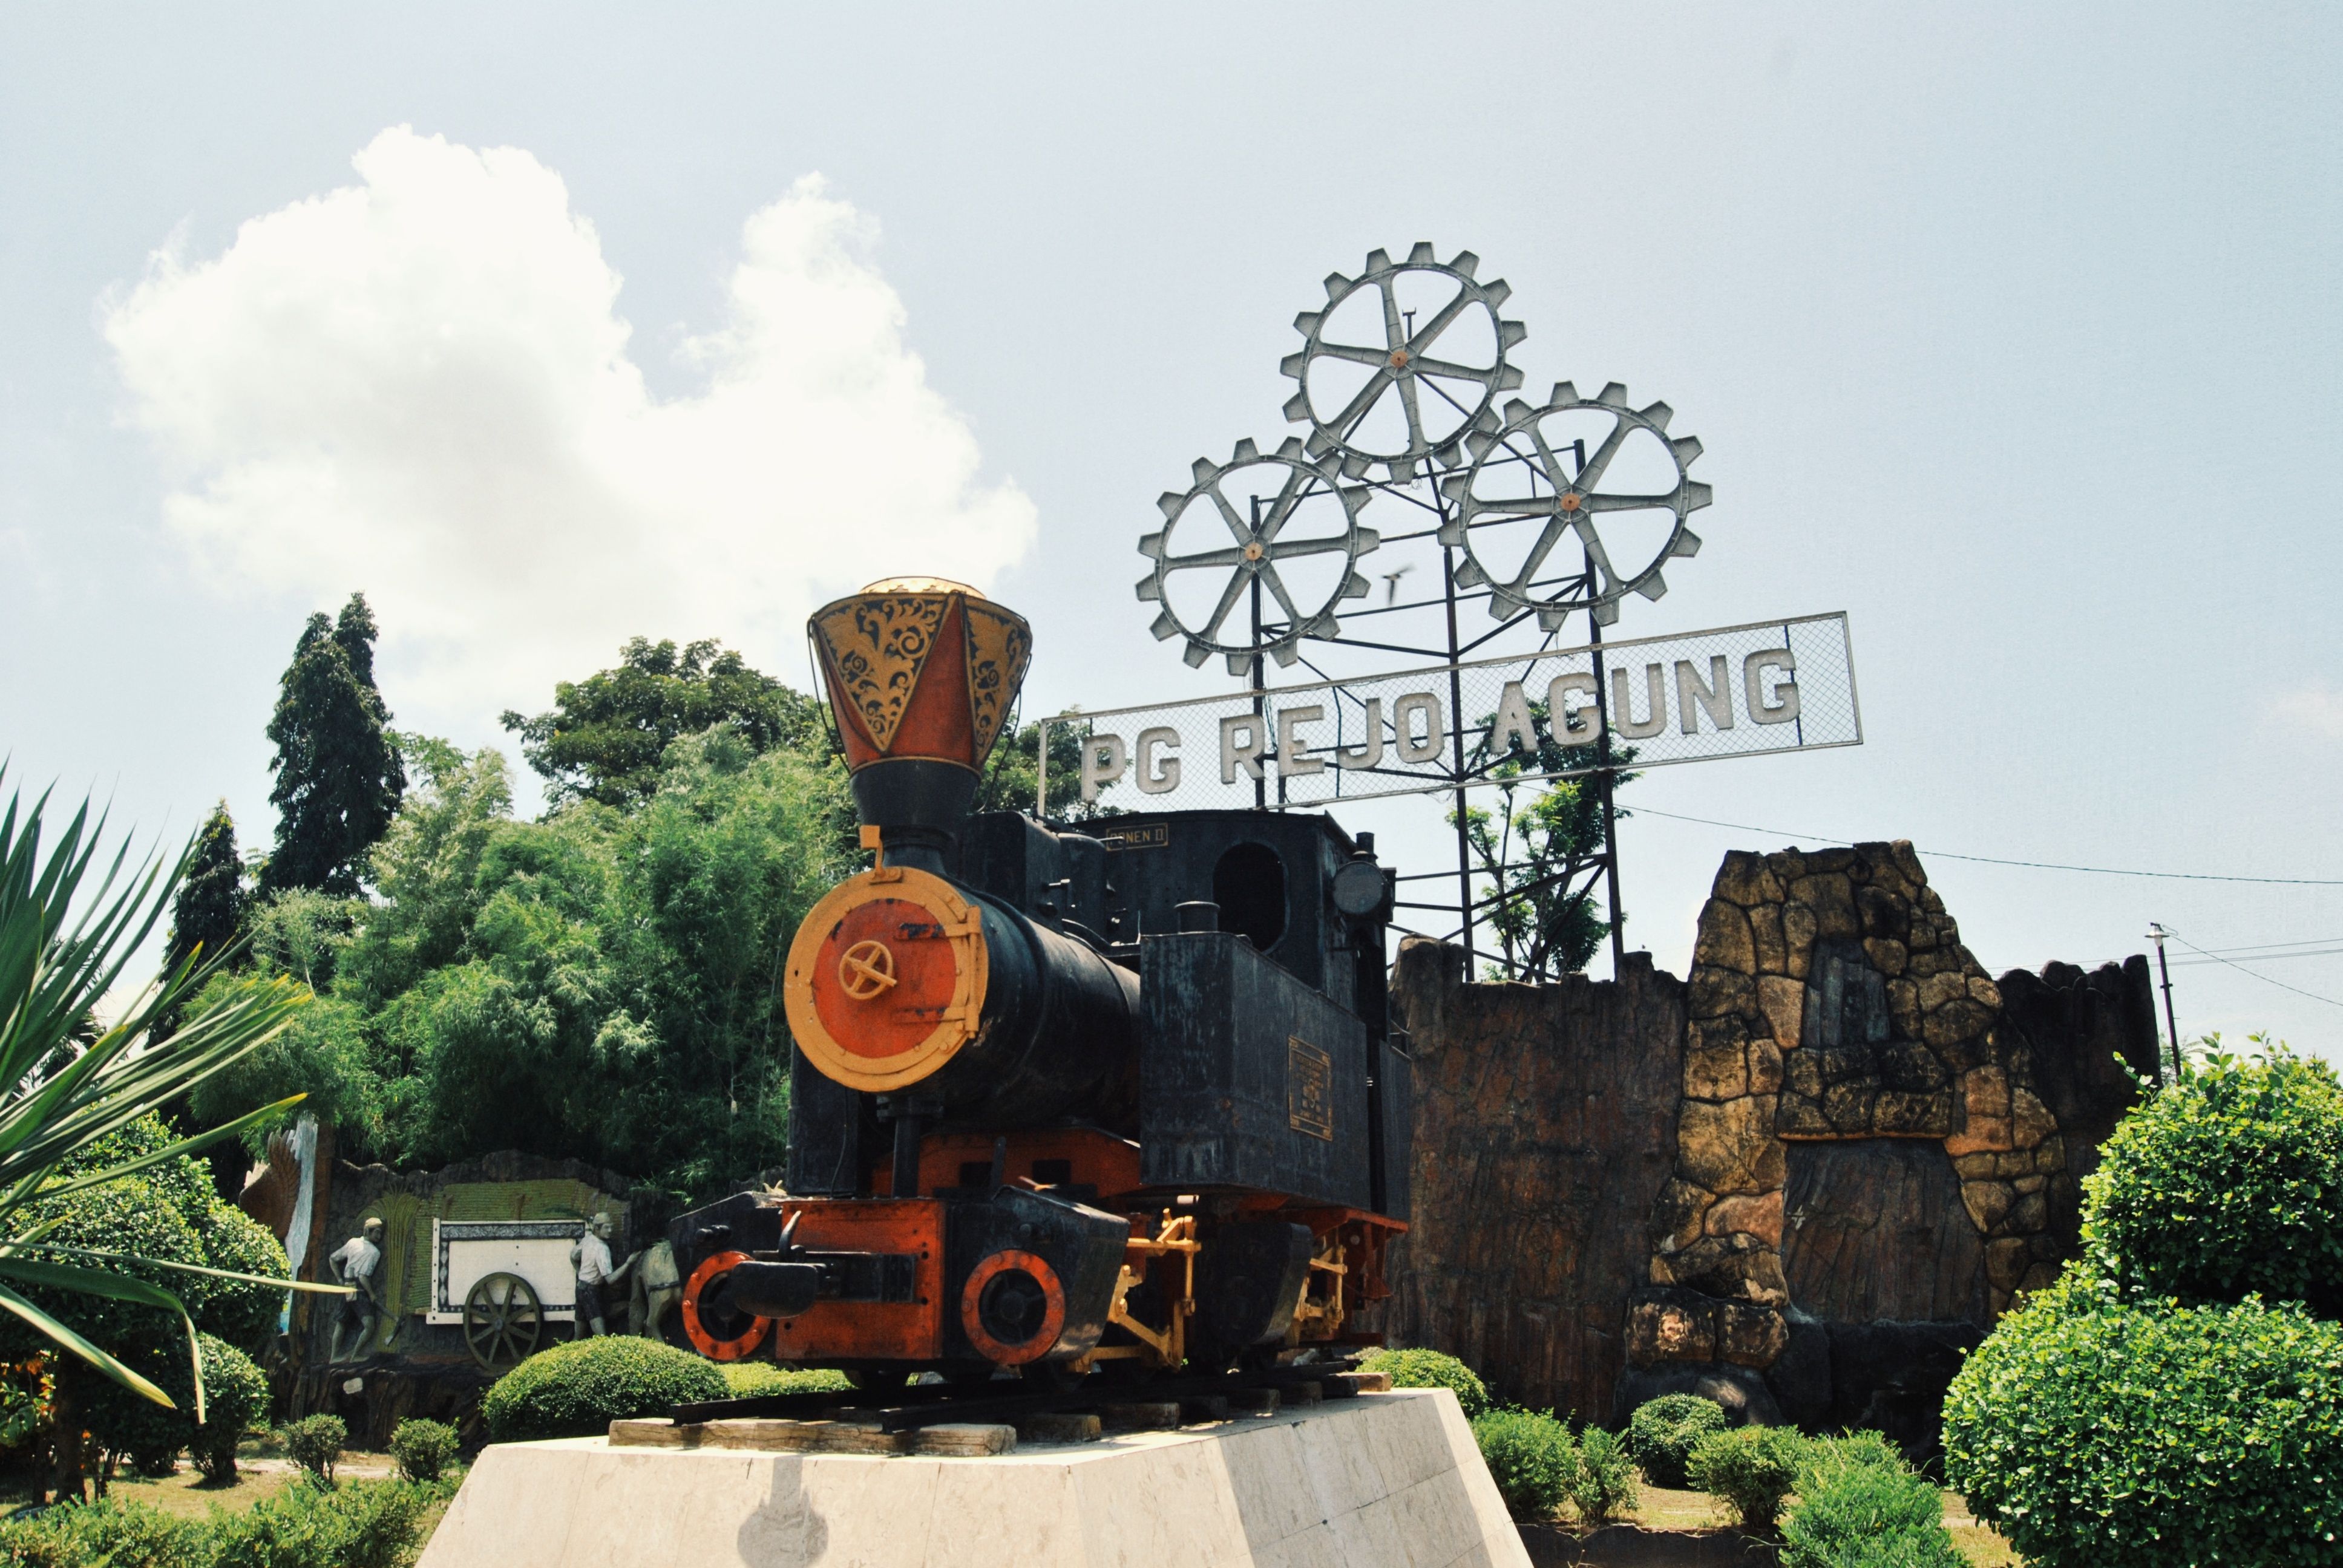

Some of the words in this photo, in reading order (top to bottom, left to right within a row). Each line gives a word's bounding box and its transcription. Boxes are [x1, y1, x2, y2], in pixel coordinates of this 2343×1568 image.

[1081, 726, 1182, 803] PG
[1219, 692, 1445, 785] REJO
[1490, 648, 1801, 754] AGUNG
